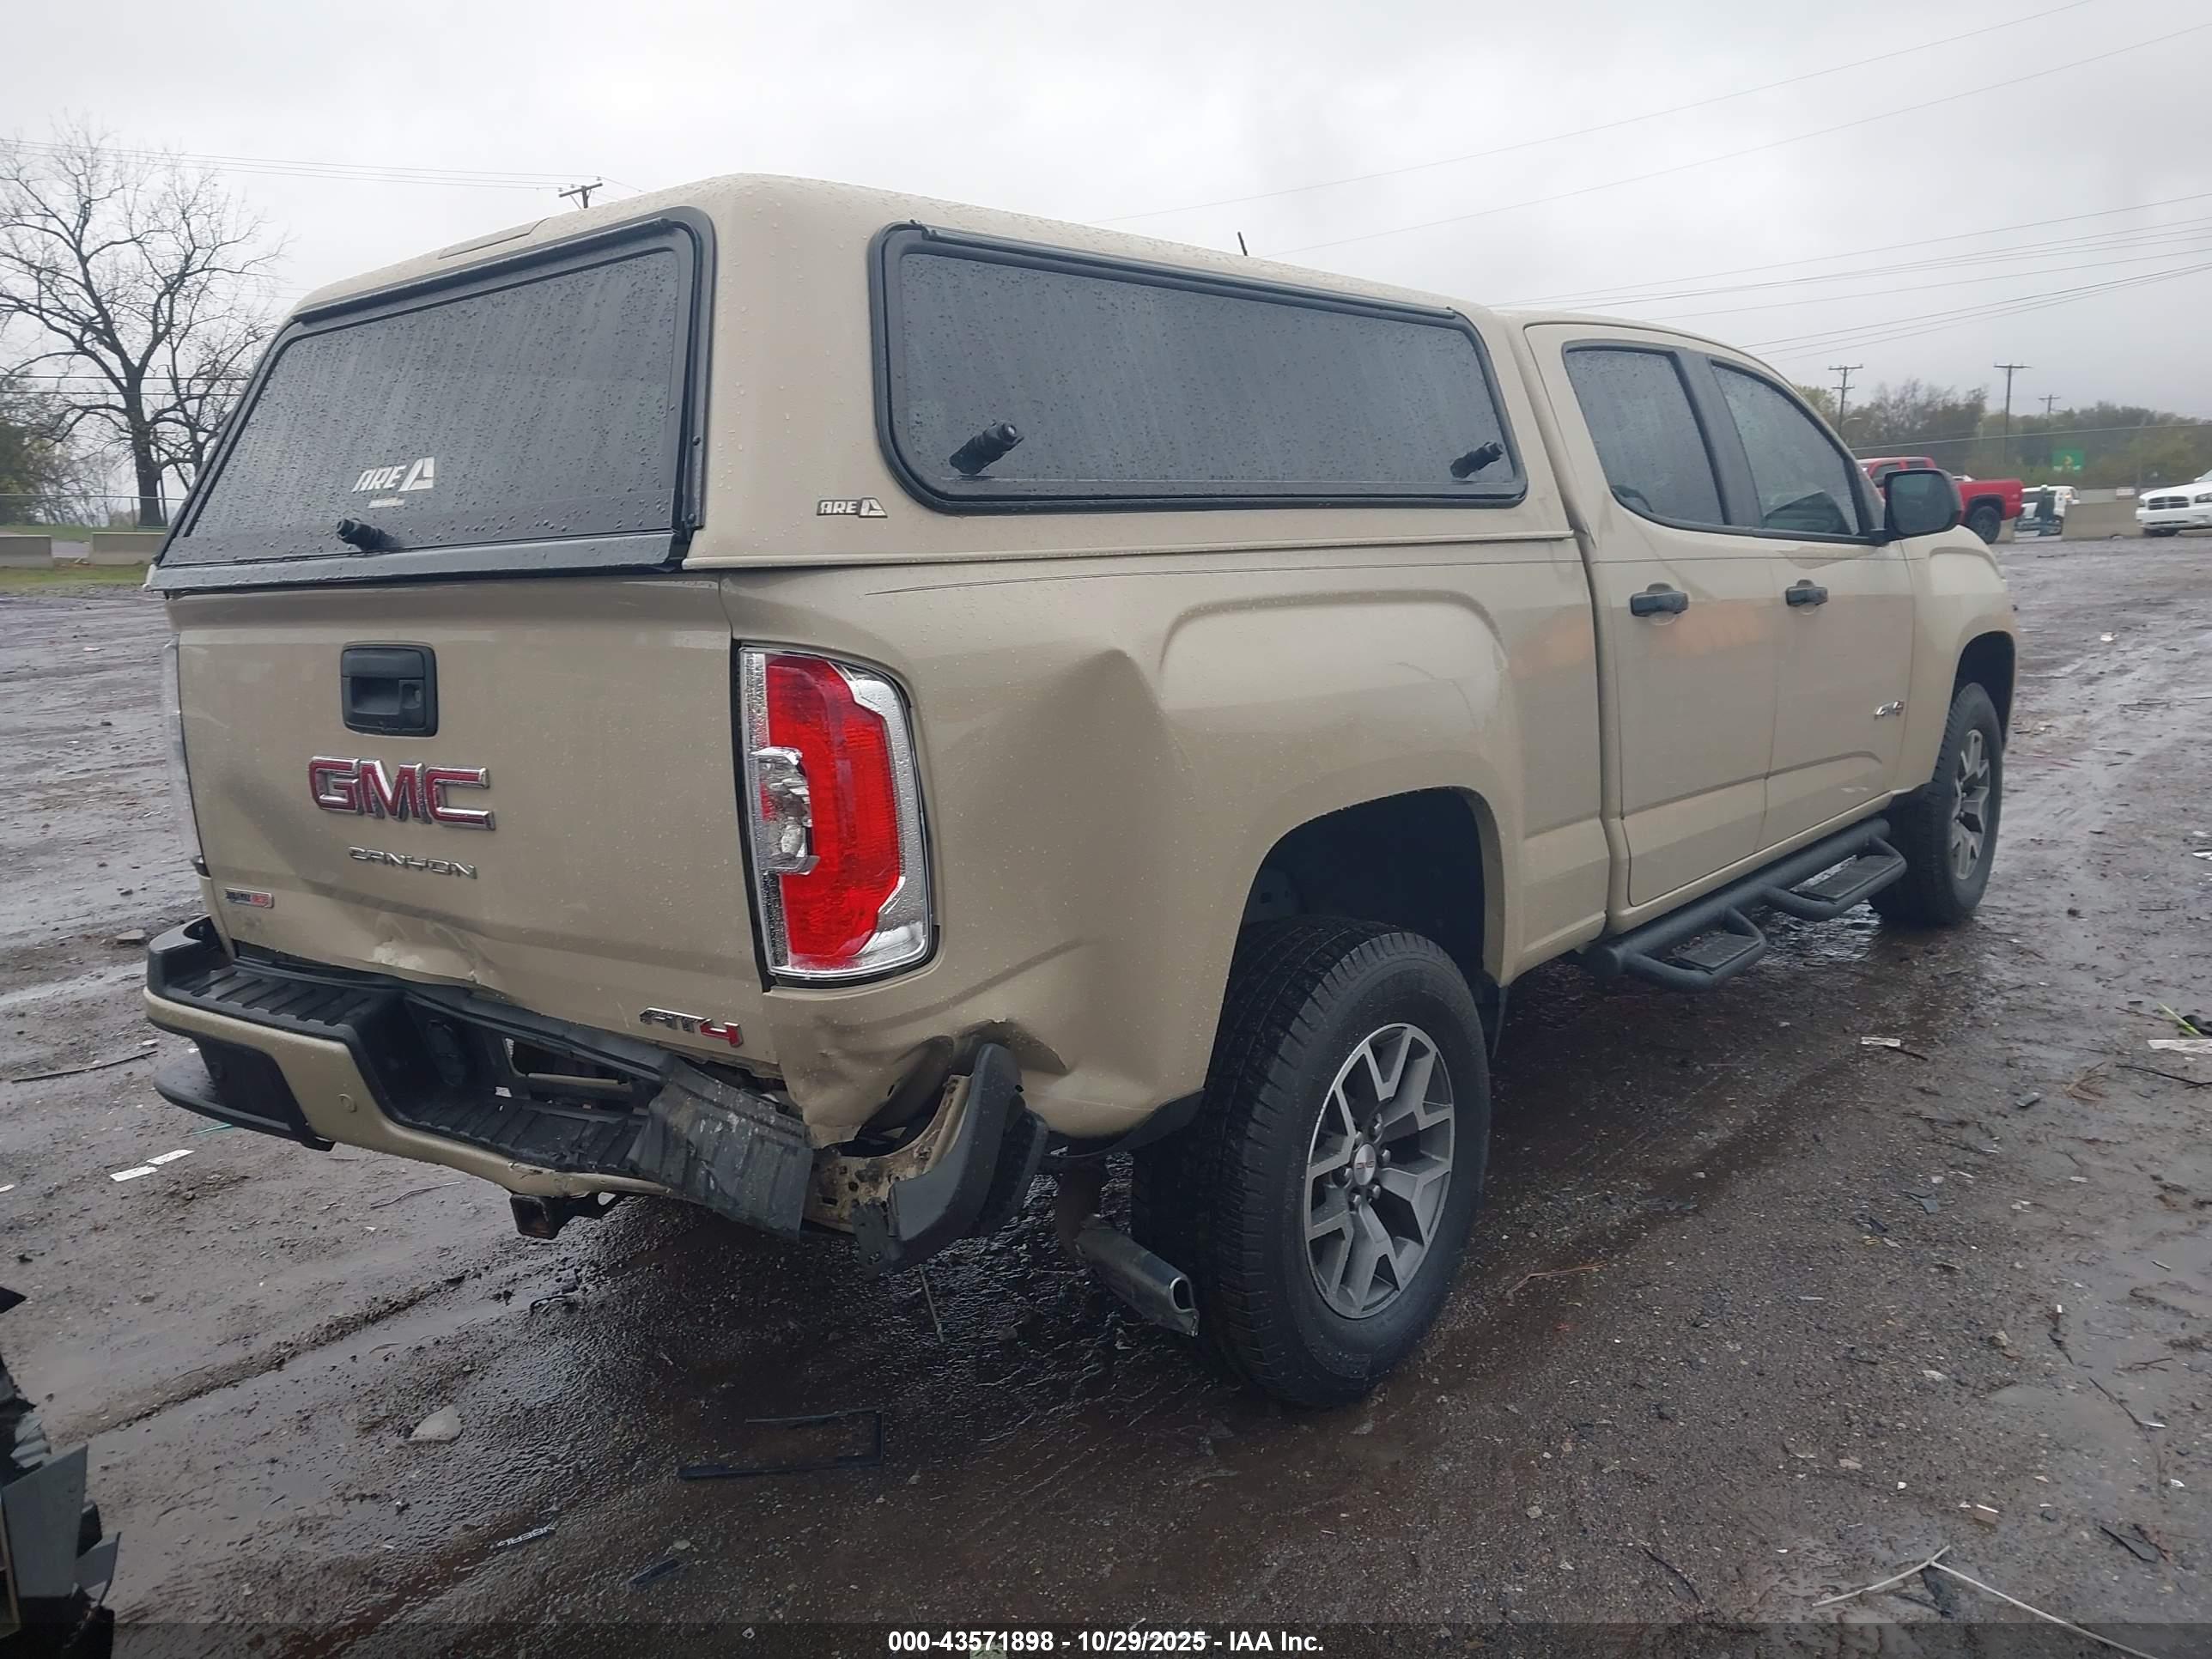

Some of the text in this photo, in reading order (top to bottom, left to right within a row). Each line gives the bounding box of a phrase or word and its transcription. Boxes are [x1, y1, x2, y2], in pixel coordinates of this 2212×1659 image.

[308, 755, 496, 831] GMC
[349, 845, 477, 879] CANYON
[639, 1006, 744, 1048] AT4
